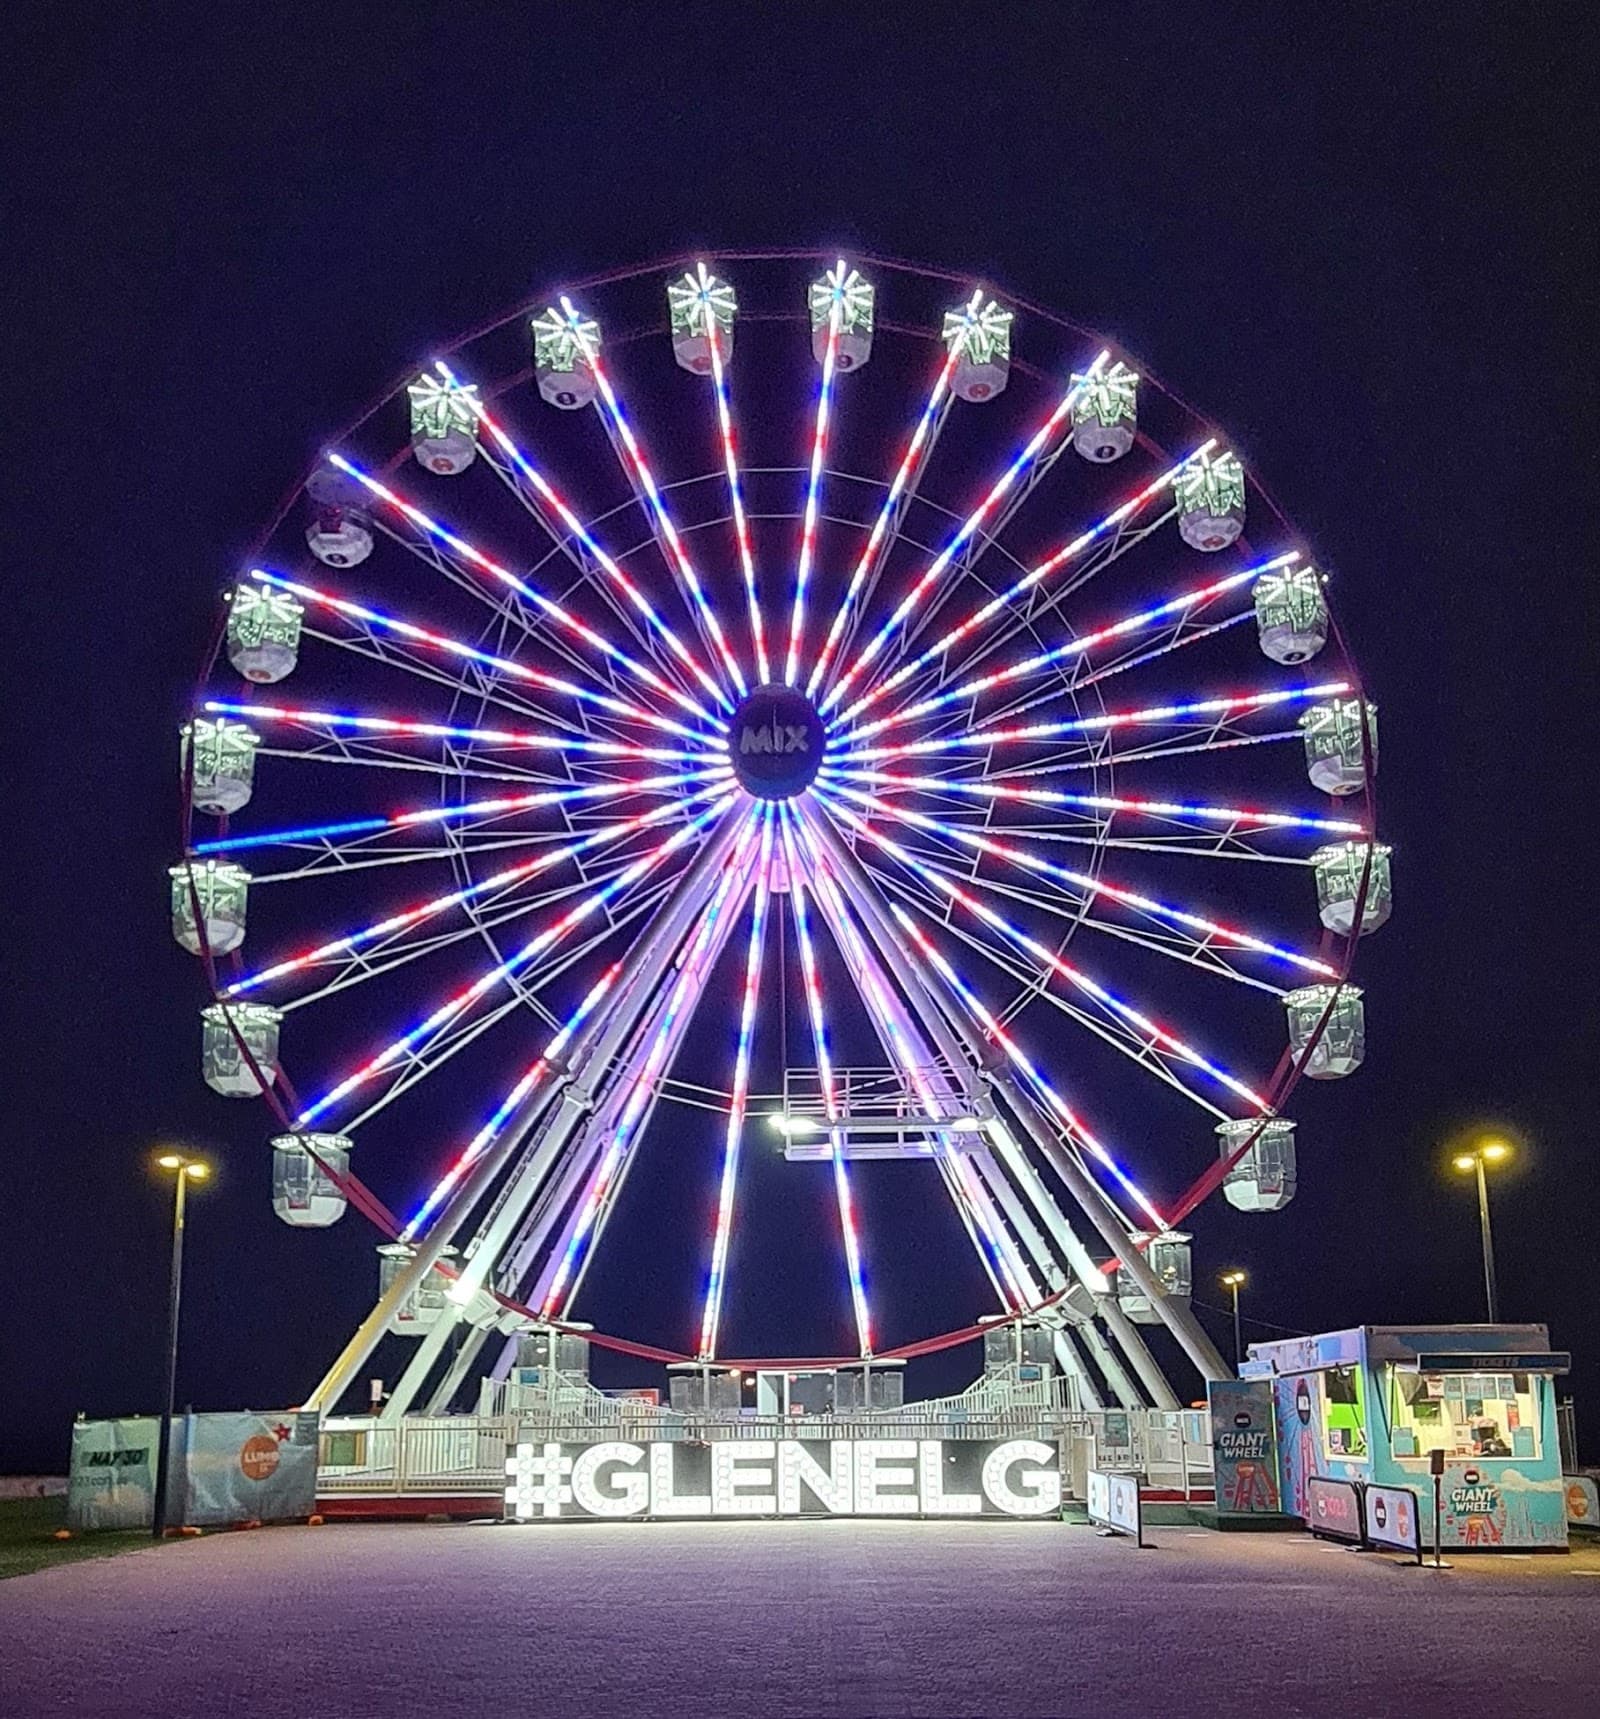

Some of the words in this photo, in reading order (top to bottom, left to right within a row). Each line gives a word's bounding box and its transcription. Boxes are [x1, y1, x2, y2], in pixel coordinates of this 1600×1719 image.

[739, 725, 809, 755] MIX
[1220, 1432, 1267, 1447] GIANT
[1223, 1447, 1265, 1458] WHEEL
[505, 1440, 1060, 1516] #GLENELG
[1451, 1487, 1495, 1502] GIANT
[1455, 1501, 1494, 1512] WHEEL
